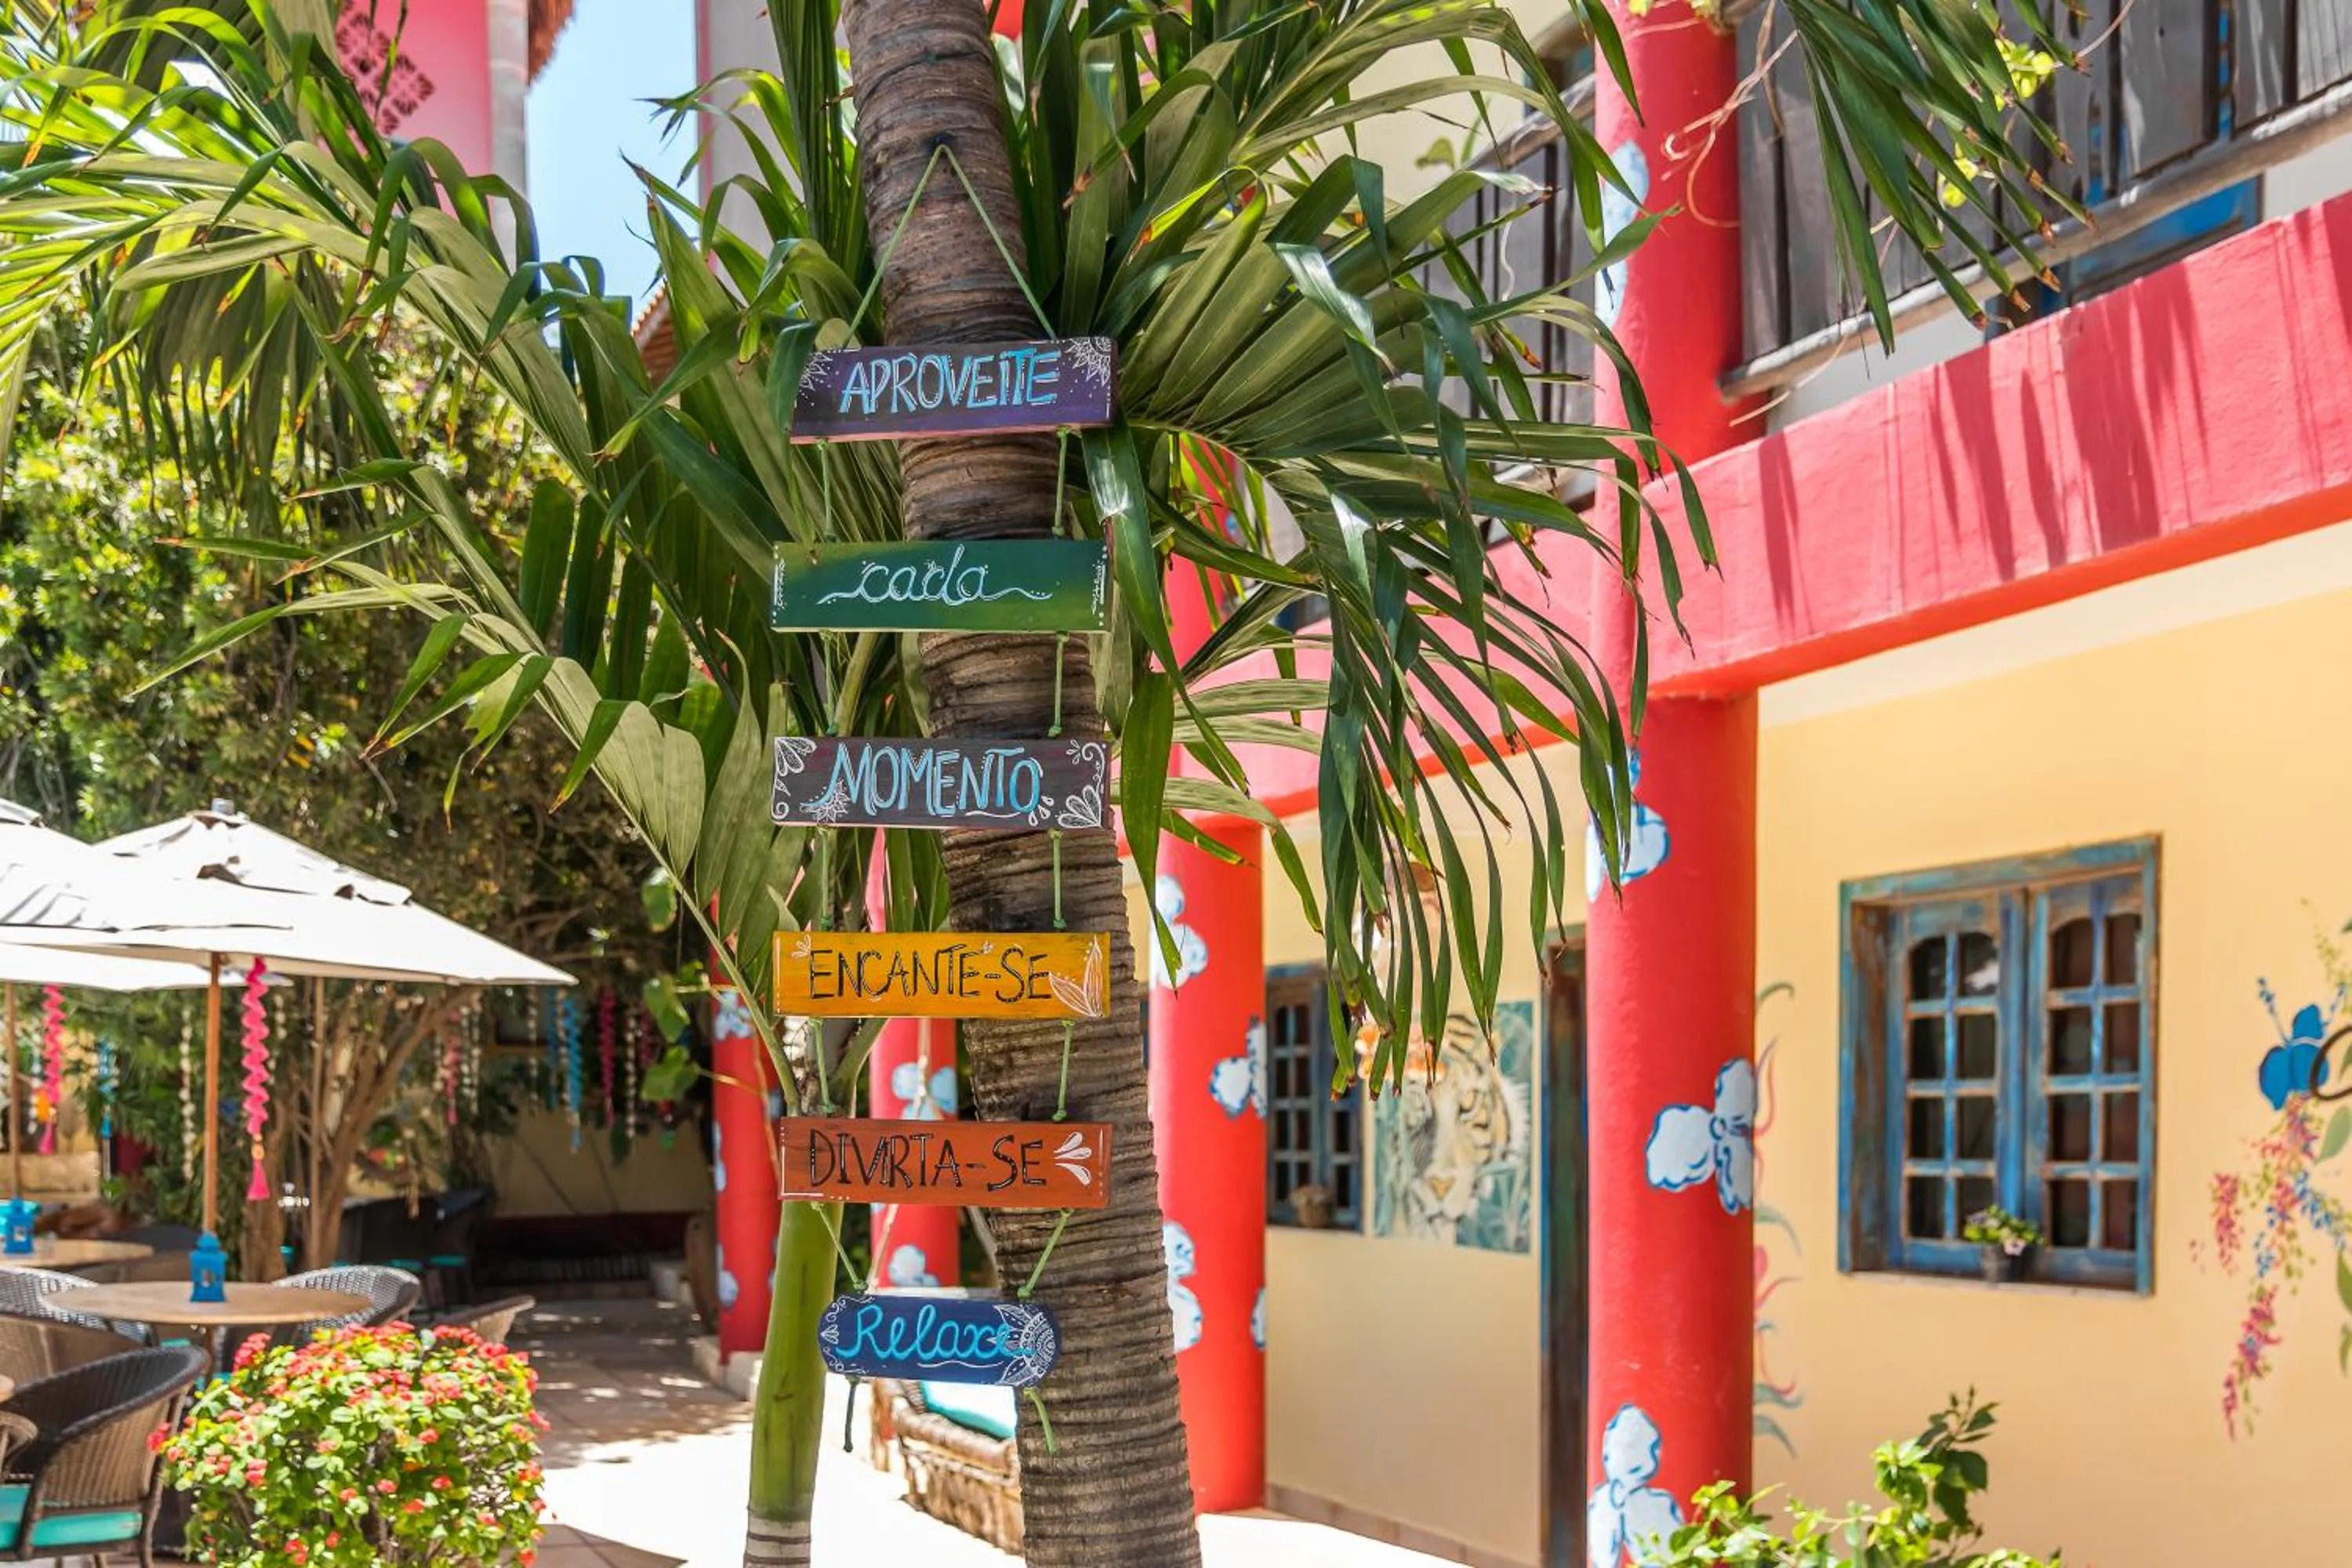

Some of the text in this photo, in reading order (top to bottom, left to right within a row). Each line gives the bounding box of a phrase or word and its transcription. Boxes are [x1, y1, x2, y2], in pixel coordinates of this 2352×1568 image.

[817, 544, 1053, 606] cada
[800, 742, 1044, 818] MOMENTO
[808, 943, 1052, 1004] ENCANTE-SE
[835, 1303, 1036, 1362] Relaxe
